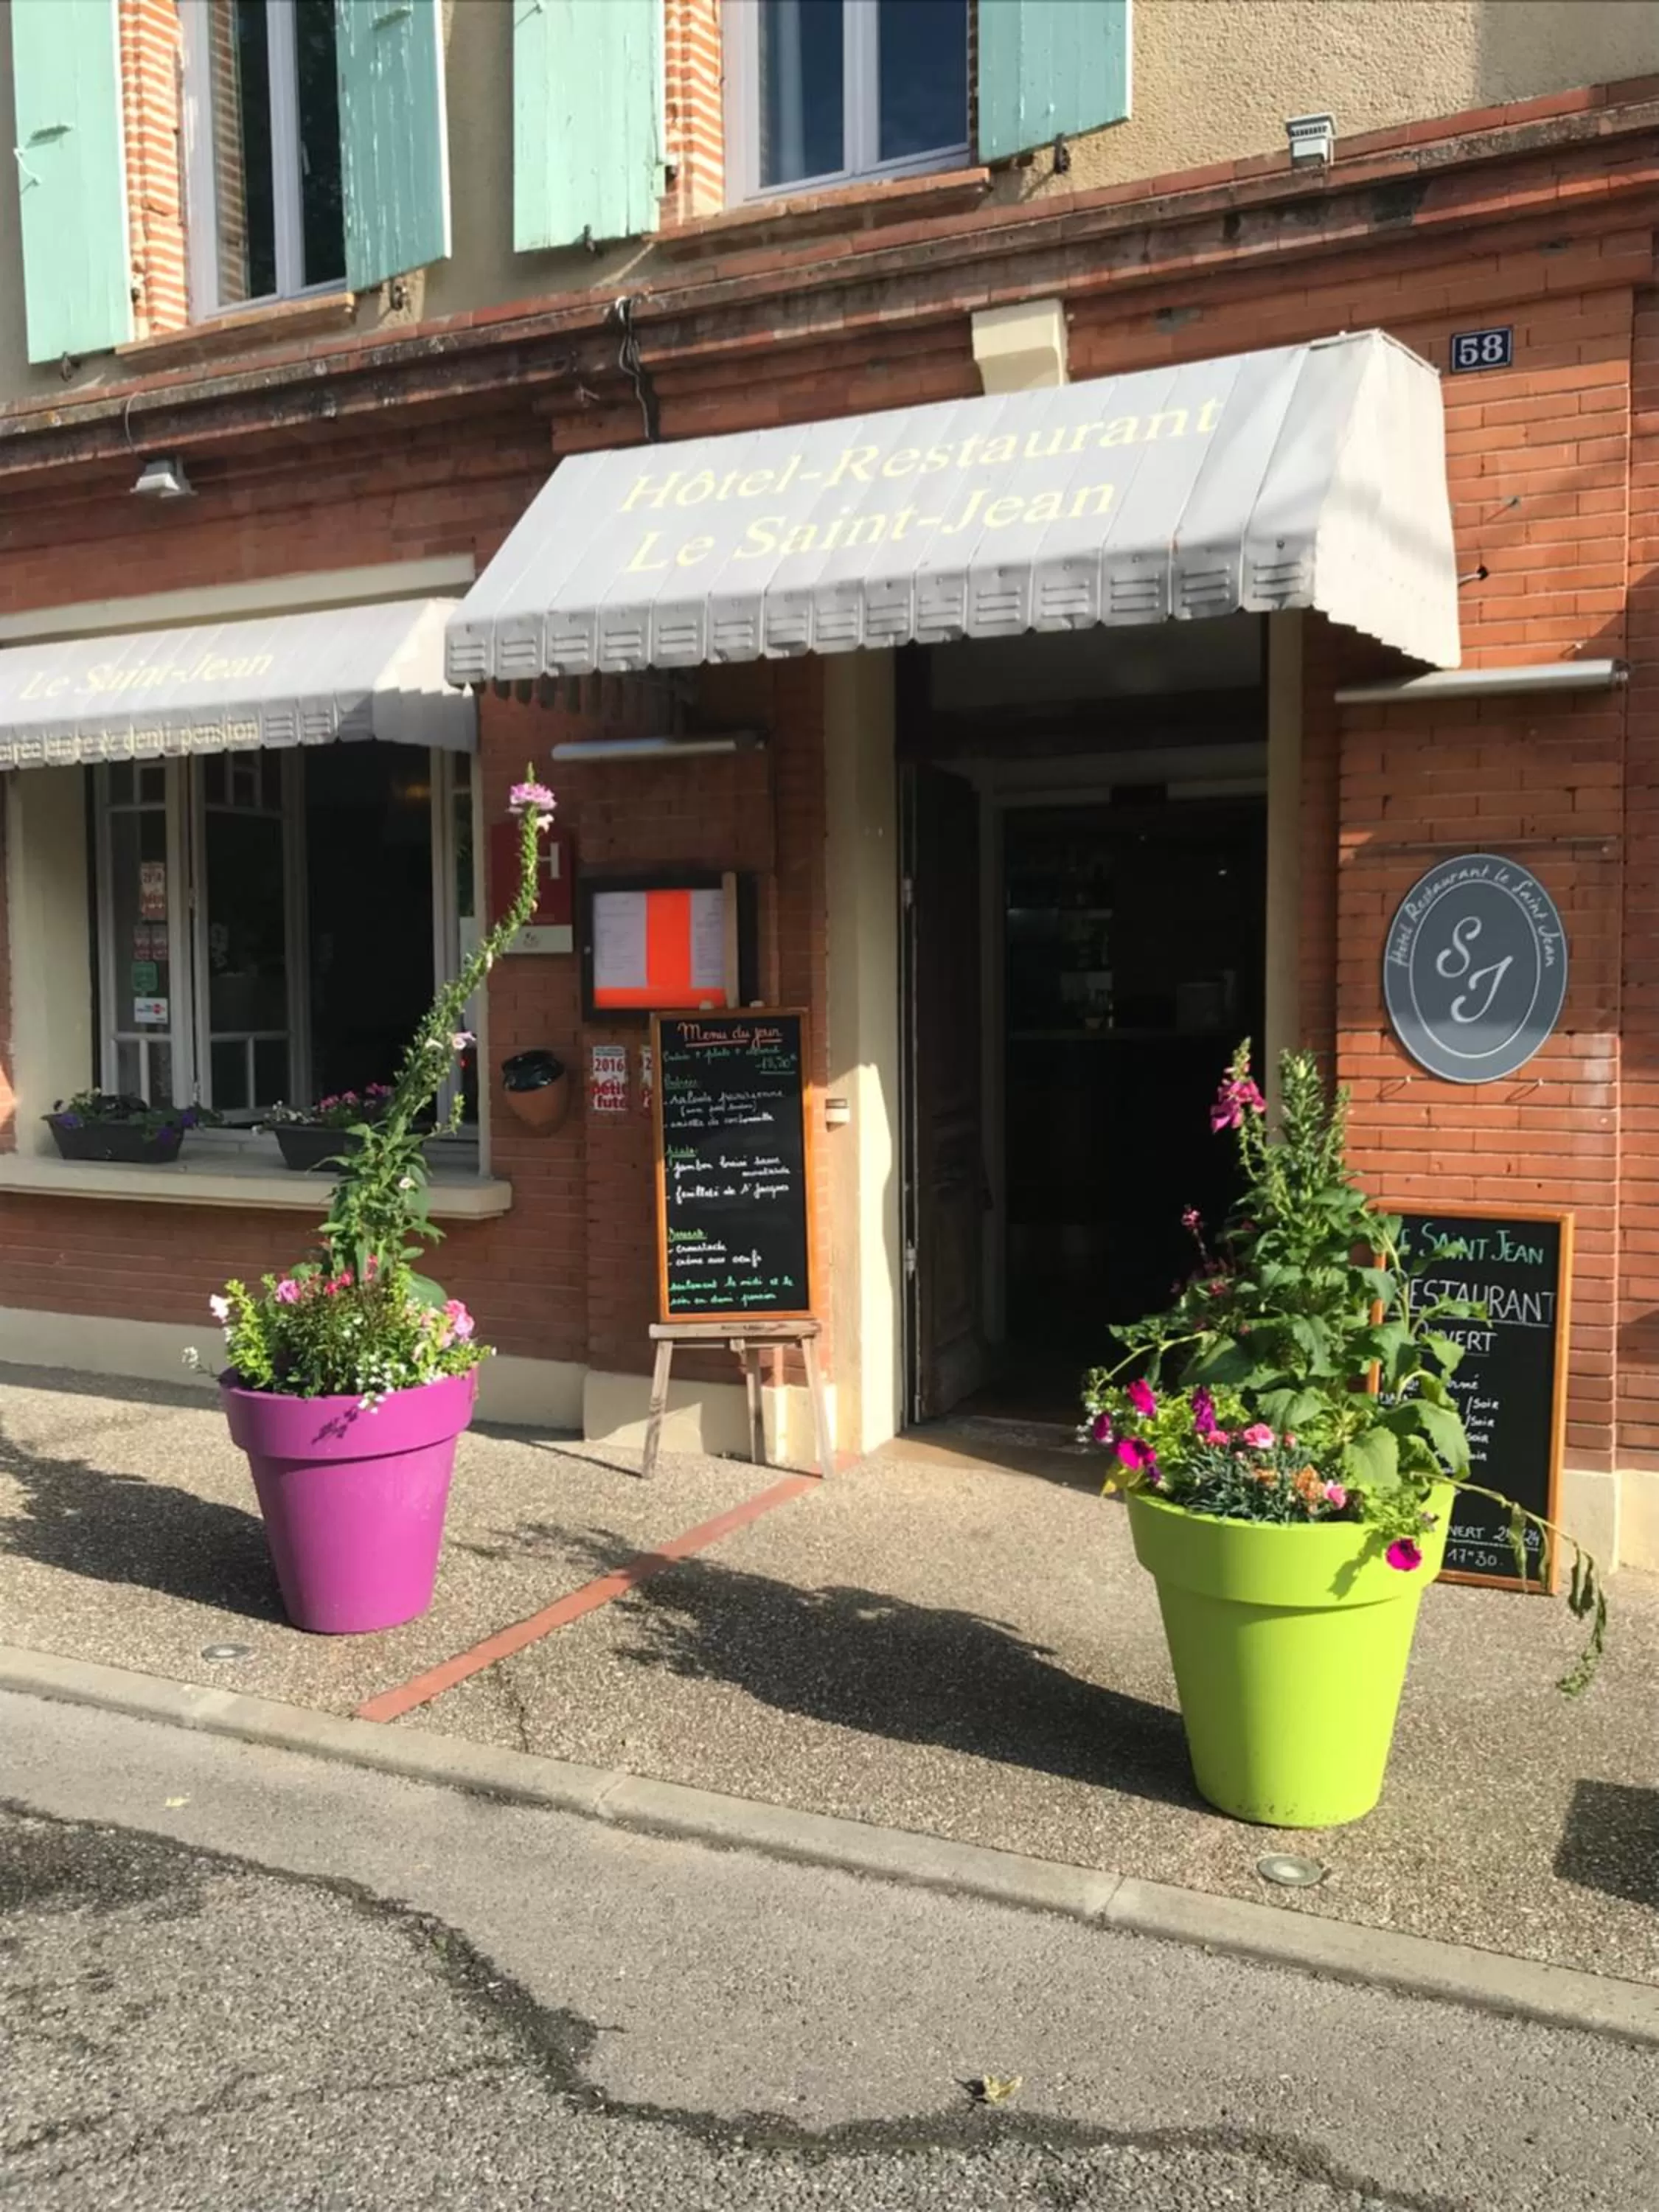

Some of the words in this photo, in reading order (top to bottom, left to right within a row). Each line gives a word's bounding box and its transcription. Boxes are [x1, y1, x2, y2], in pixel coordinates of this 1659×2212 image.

[1460, 334, 1503, 365] 58
[621, 397, 1225, 513] Hôtel-Restaurant
[626, 530, 715, 574] Le
[734, 481, 1115, 561] Saint-Jean
[19, 670, 70, 700] Le
[75, 653, 274, 693] Saint-Jean
[1404, 864, 1489, 923] Restaurant
[1512, 880, 1548, 919] Saint
[1538, 925, 1561, 968] Jean
[677, 1022, 727, 1043] Menu
[731, 1023, 750, 1040] du
[594, 1057, 625, 1072] 2016
[1420, 1222, 1489, 1262] SANT
[1490, 1229, 1544, 1265] JEAN
